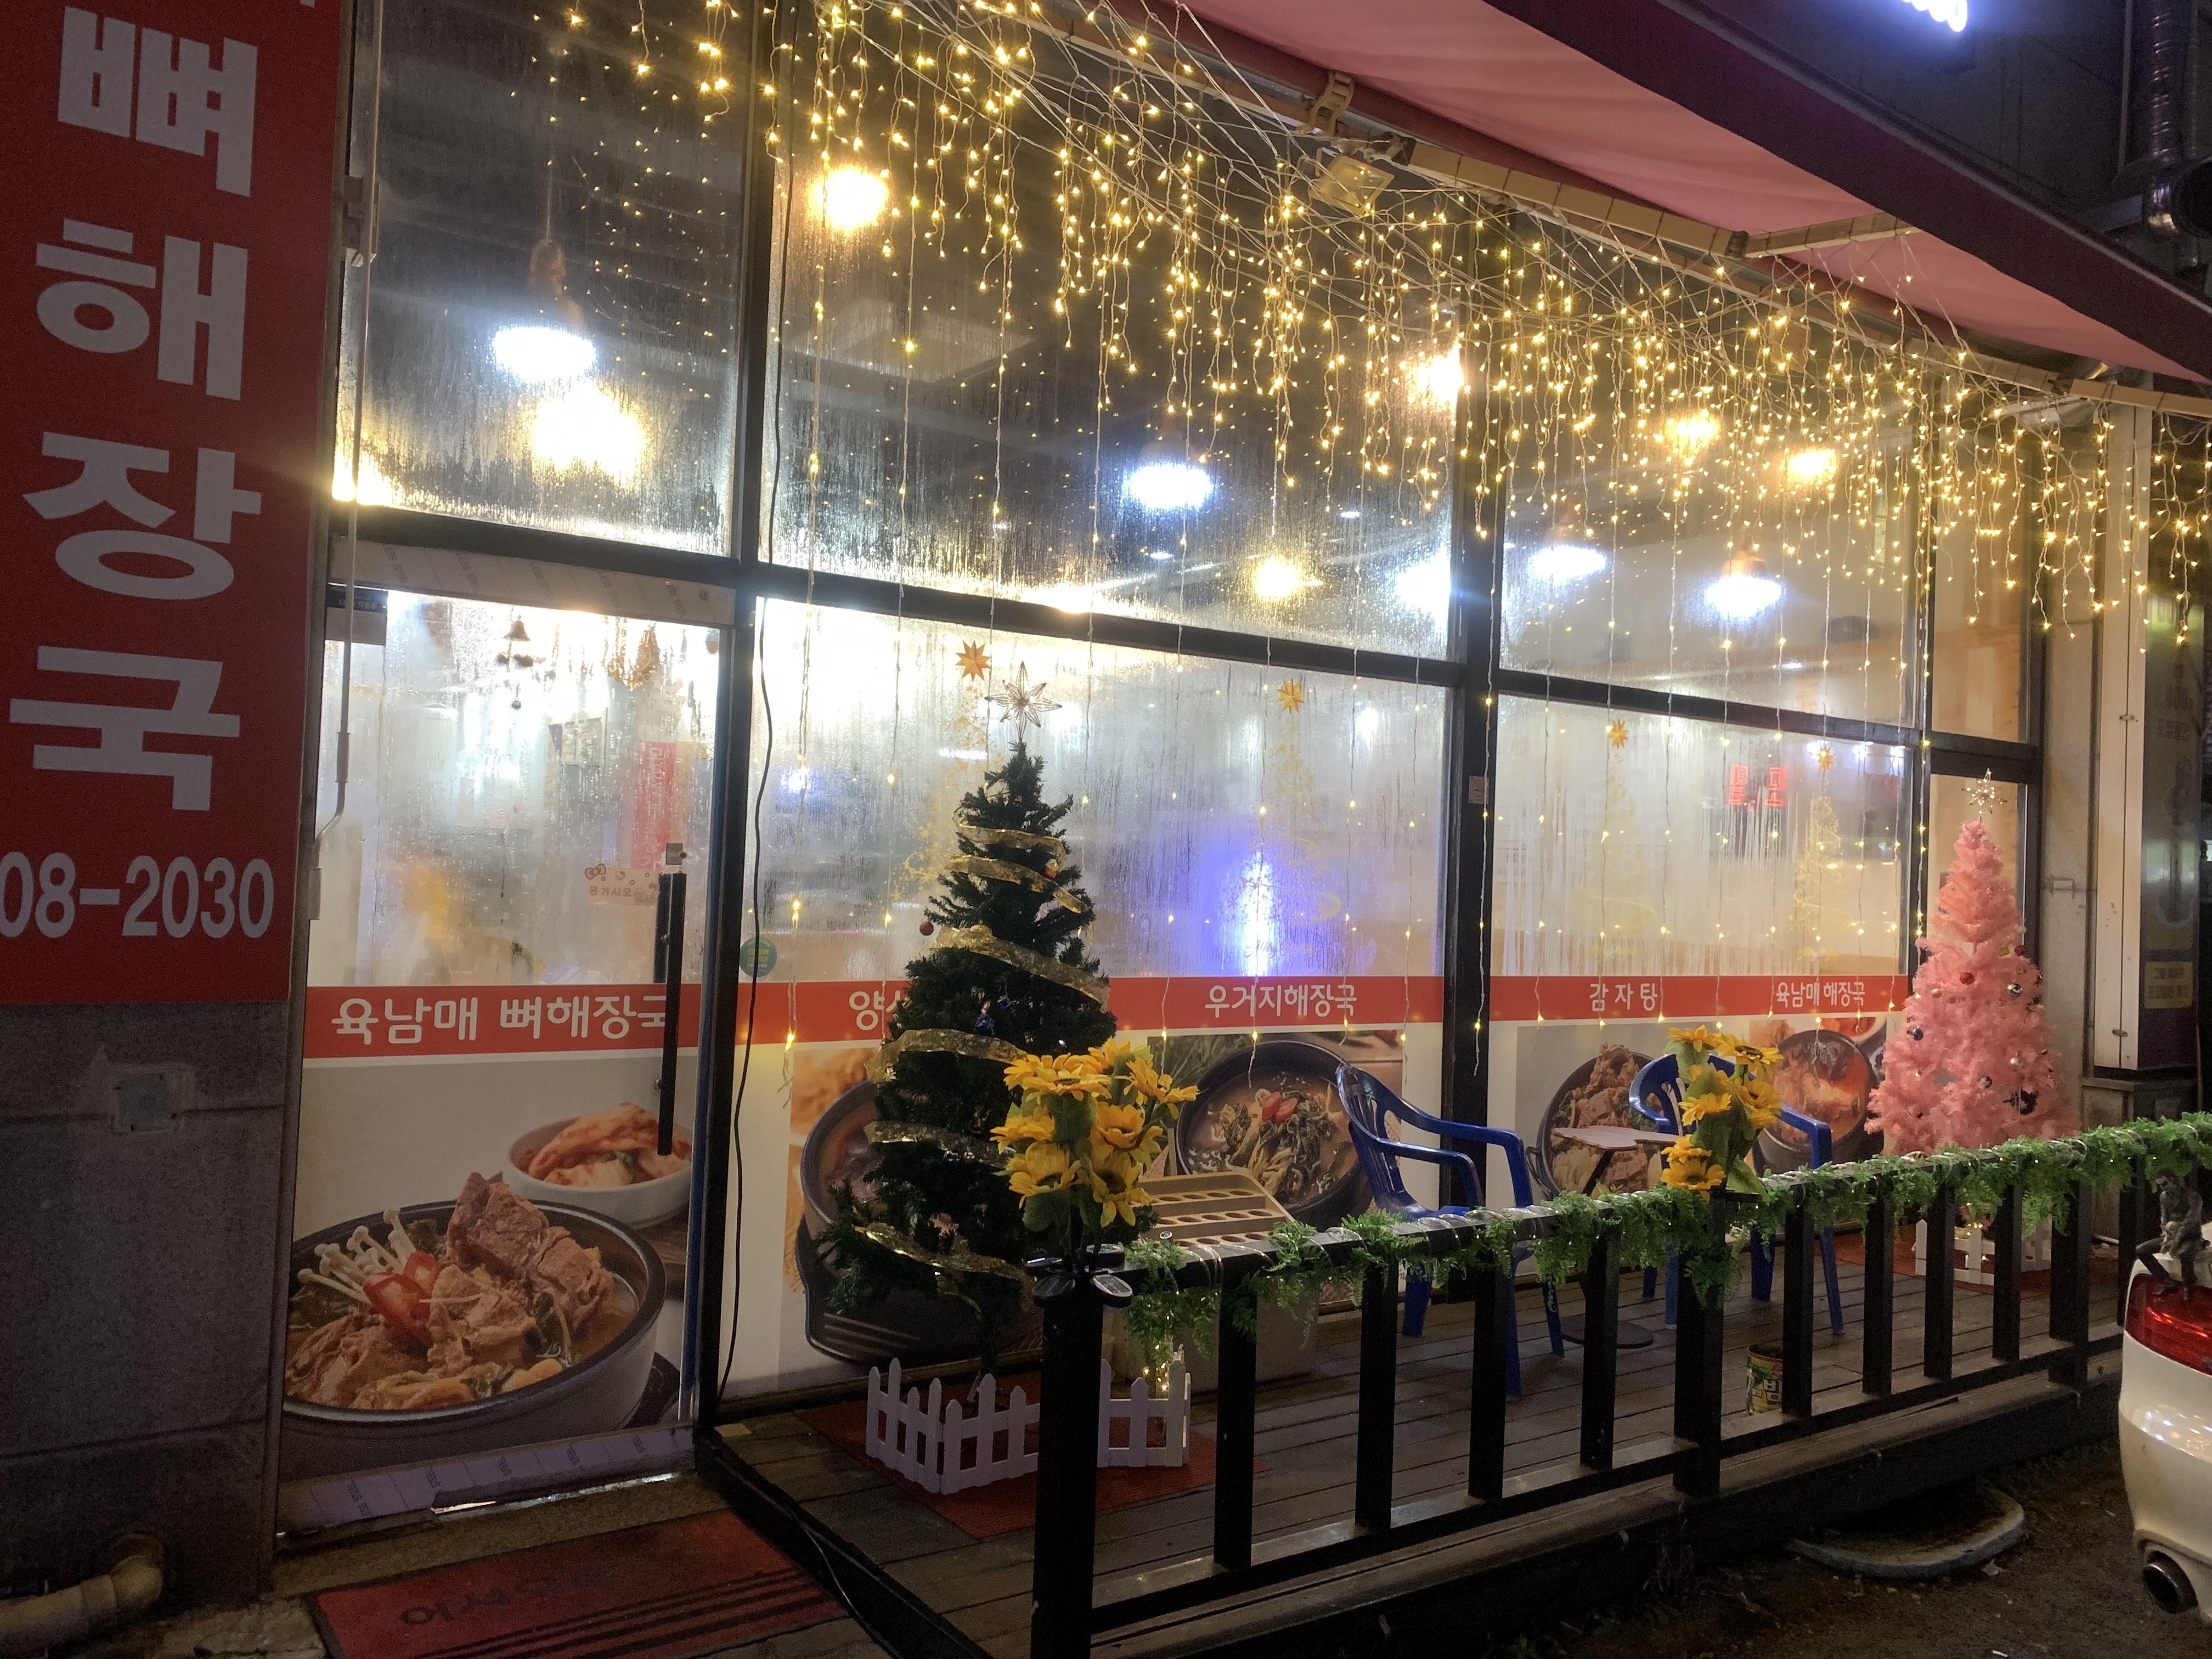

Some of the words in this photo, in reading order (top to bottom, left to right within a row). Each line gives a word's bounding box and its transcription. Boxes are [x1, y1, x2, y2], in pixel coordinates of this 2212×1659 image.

[10, 5, 261, 811] 뼈해장국
[0, 851, 274, 939] 08-2030
[331, 997, 478, 1045] 육남매
[1205, 984, 1357, 1018] 우거지해장국
[1589, 983, 1658, 1011] 감자탕
